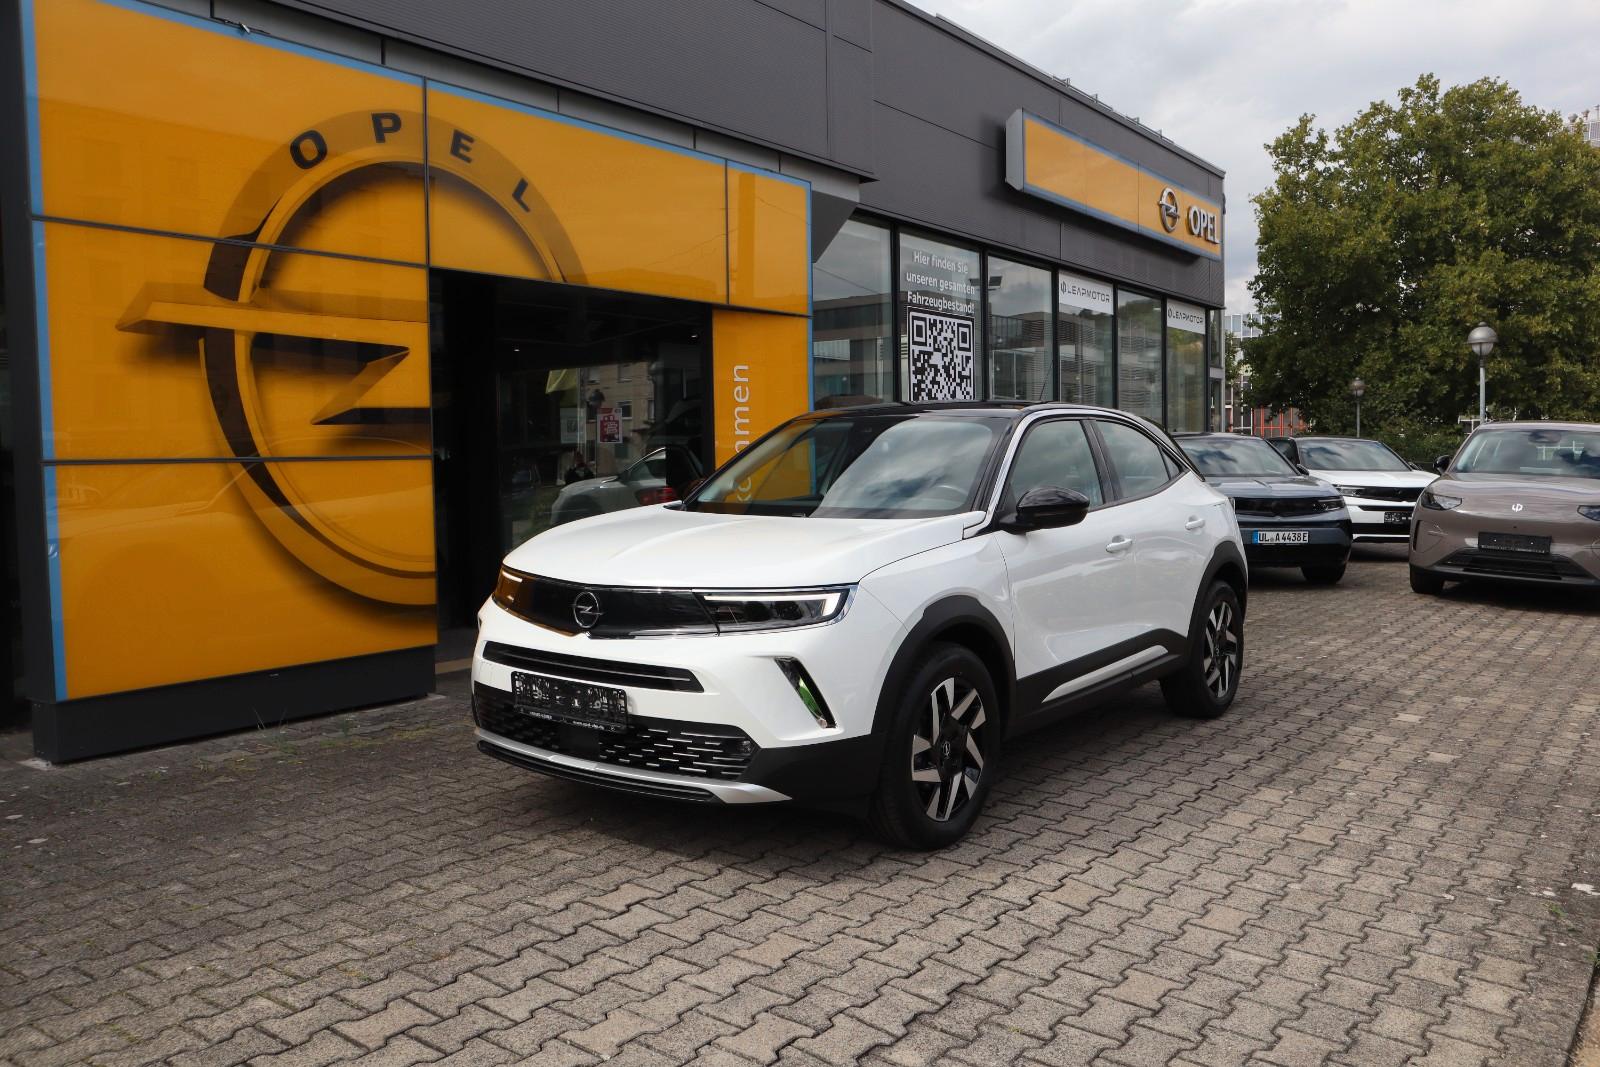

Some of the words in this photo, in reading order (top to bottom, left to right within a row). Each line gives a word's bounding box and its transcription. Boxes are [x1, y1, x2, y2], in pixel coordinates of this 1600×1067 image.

[289, 112, 531, 213] OPEL
[1187, 205, 1220, 245] OPEL
[913, 251, 930, 266] Hier
[931, 255, 956, 271] finden
[957, 261, 969, 274] Sie
[906, 272, 938, 288] unseren
[939, 279, 975, 296] gesamten
[1067, 284, 1110, 303] LEAPMOTOR
[907, 291, 975, 314] Fahrzeugbestand!
[1258, 532, 1270, 542] UL
